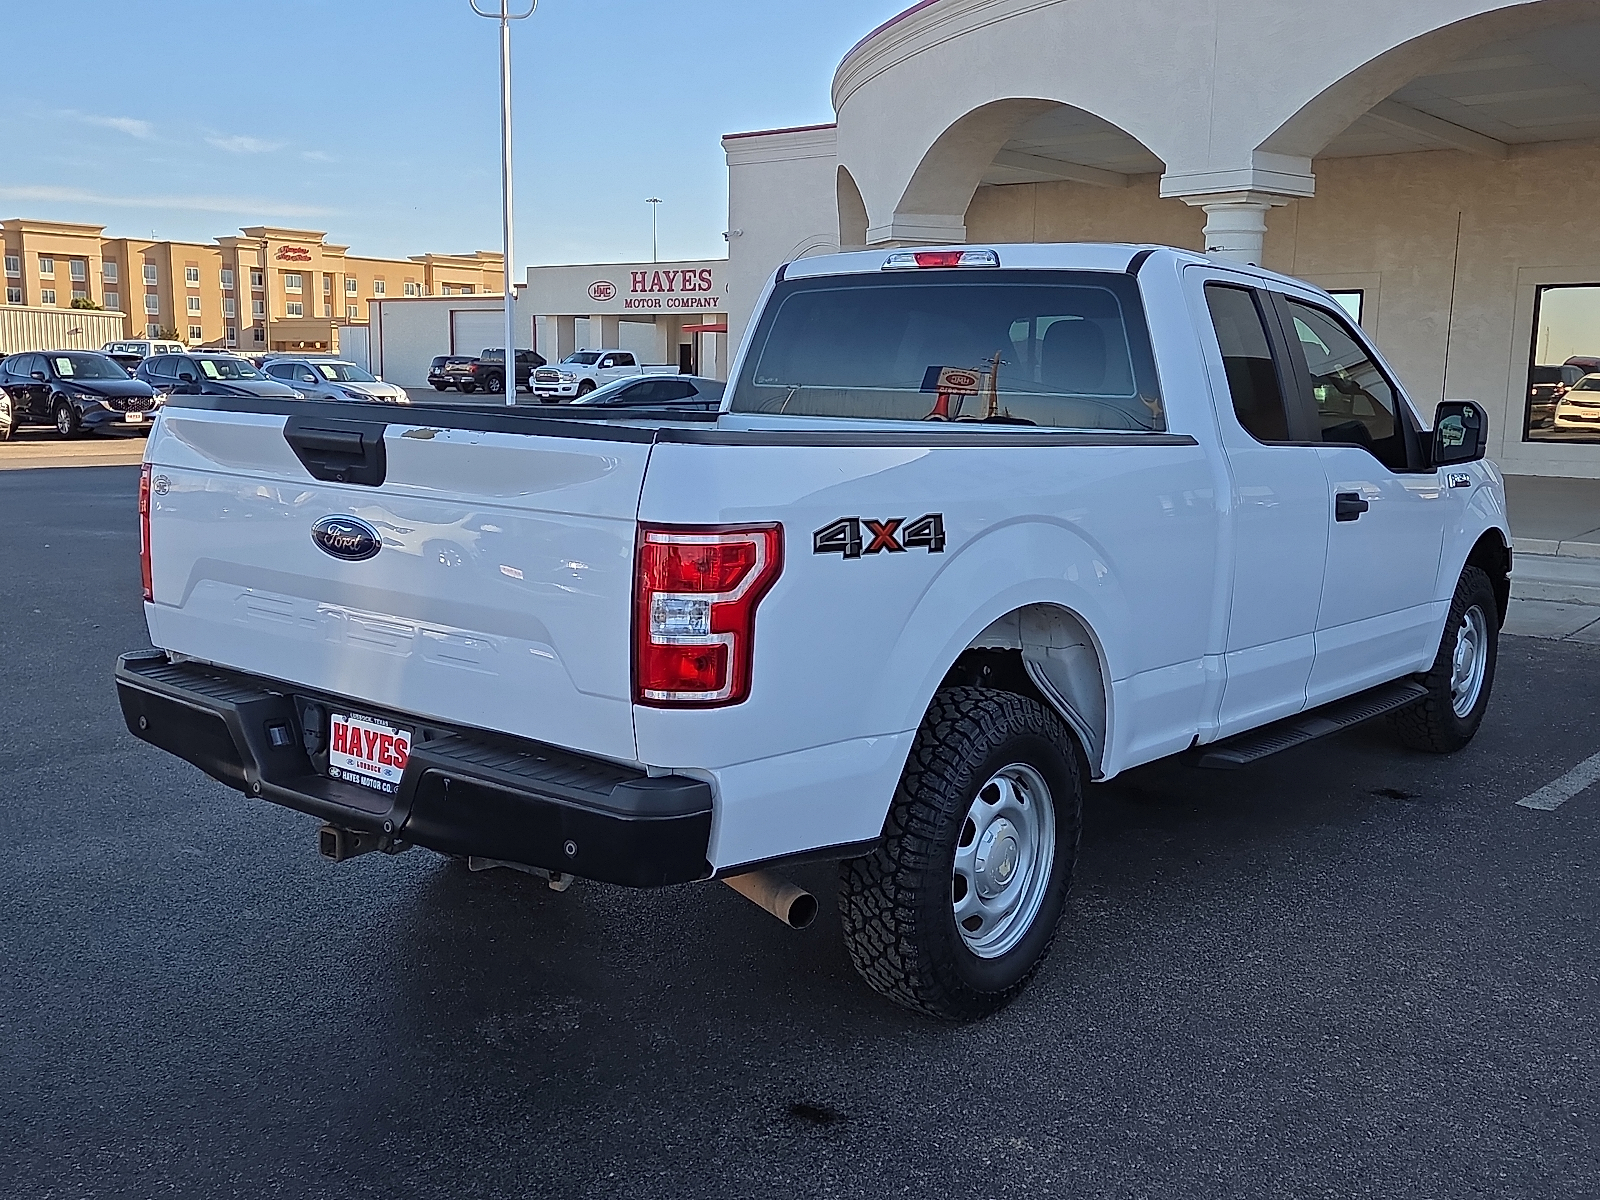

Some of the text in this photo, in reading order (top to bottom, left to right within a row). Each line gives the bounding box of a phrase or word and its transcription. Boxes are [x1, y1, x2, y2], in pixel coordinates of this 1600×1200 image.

[630, 268, 712, 293] HAYES
[624, 296, 720, 309] MOTOR COMPANY
[324, 523, 361, 551] Ford
[332, 721, 409, 770] HAYES
[342, 770, 360, 784] HAYES
[360, 776, 381, 790] MOTOR
